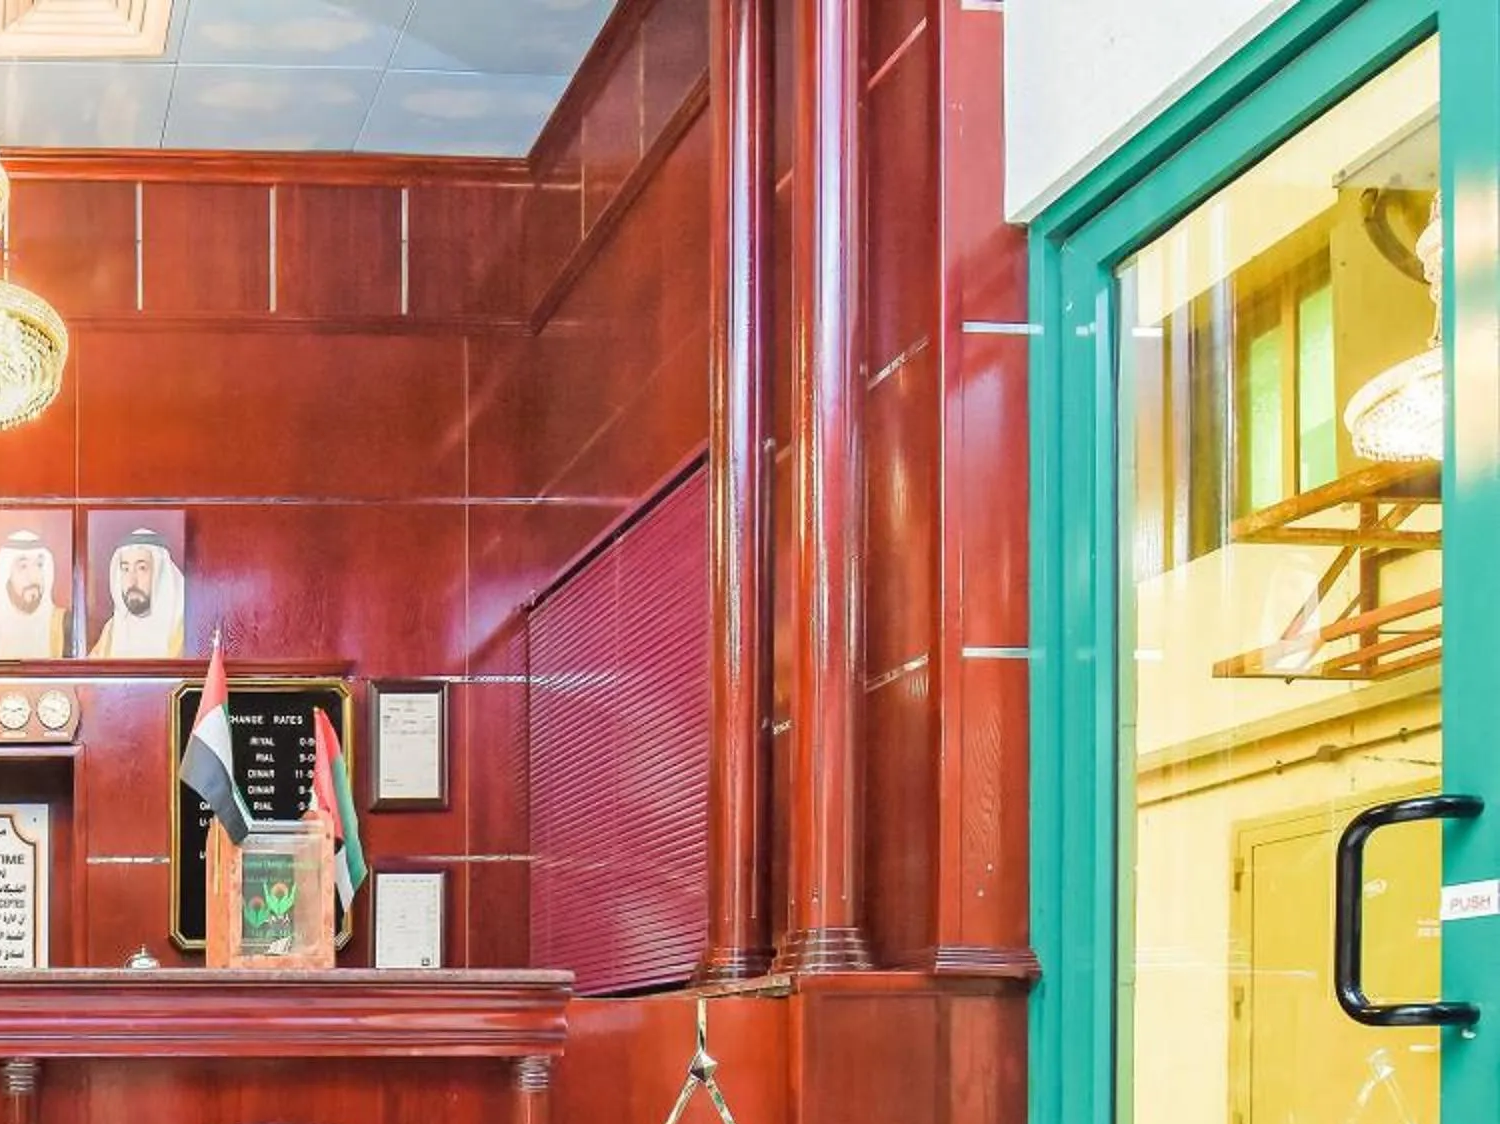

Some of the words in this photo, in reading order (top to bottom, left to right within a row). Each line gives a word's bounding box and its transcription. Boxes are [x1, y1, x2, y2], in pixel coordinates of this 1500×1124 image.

[228, 715, 264, 725] CHANGE
[273, 715, 303, 725] RATES
[249, 736, 275, 746] RIYAL
[255, 753, 275, 763] RIAL
[247, 769, 275, 779] DINAR
[247, 785, 275, 795] DINAR
[253, 801, 273, 811] RIAL
[1450, 895, 1491, 912] PUSH
